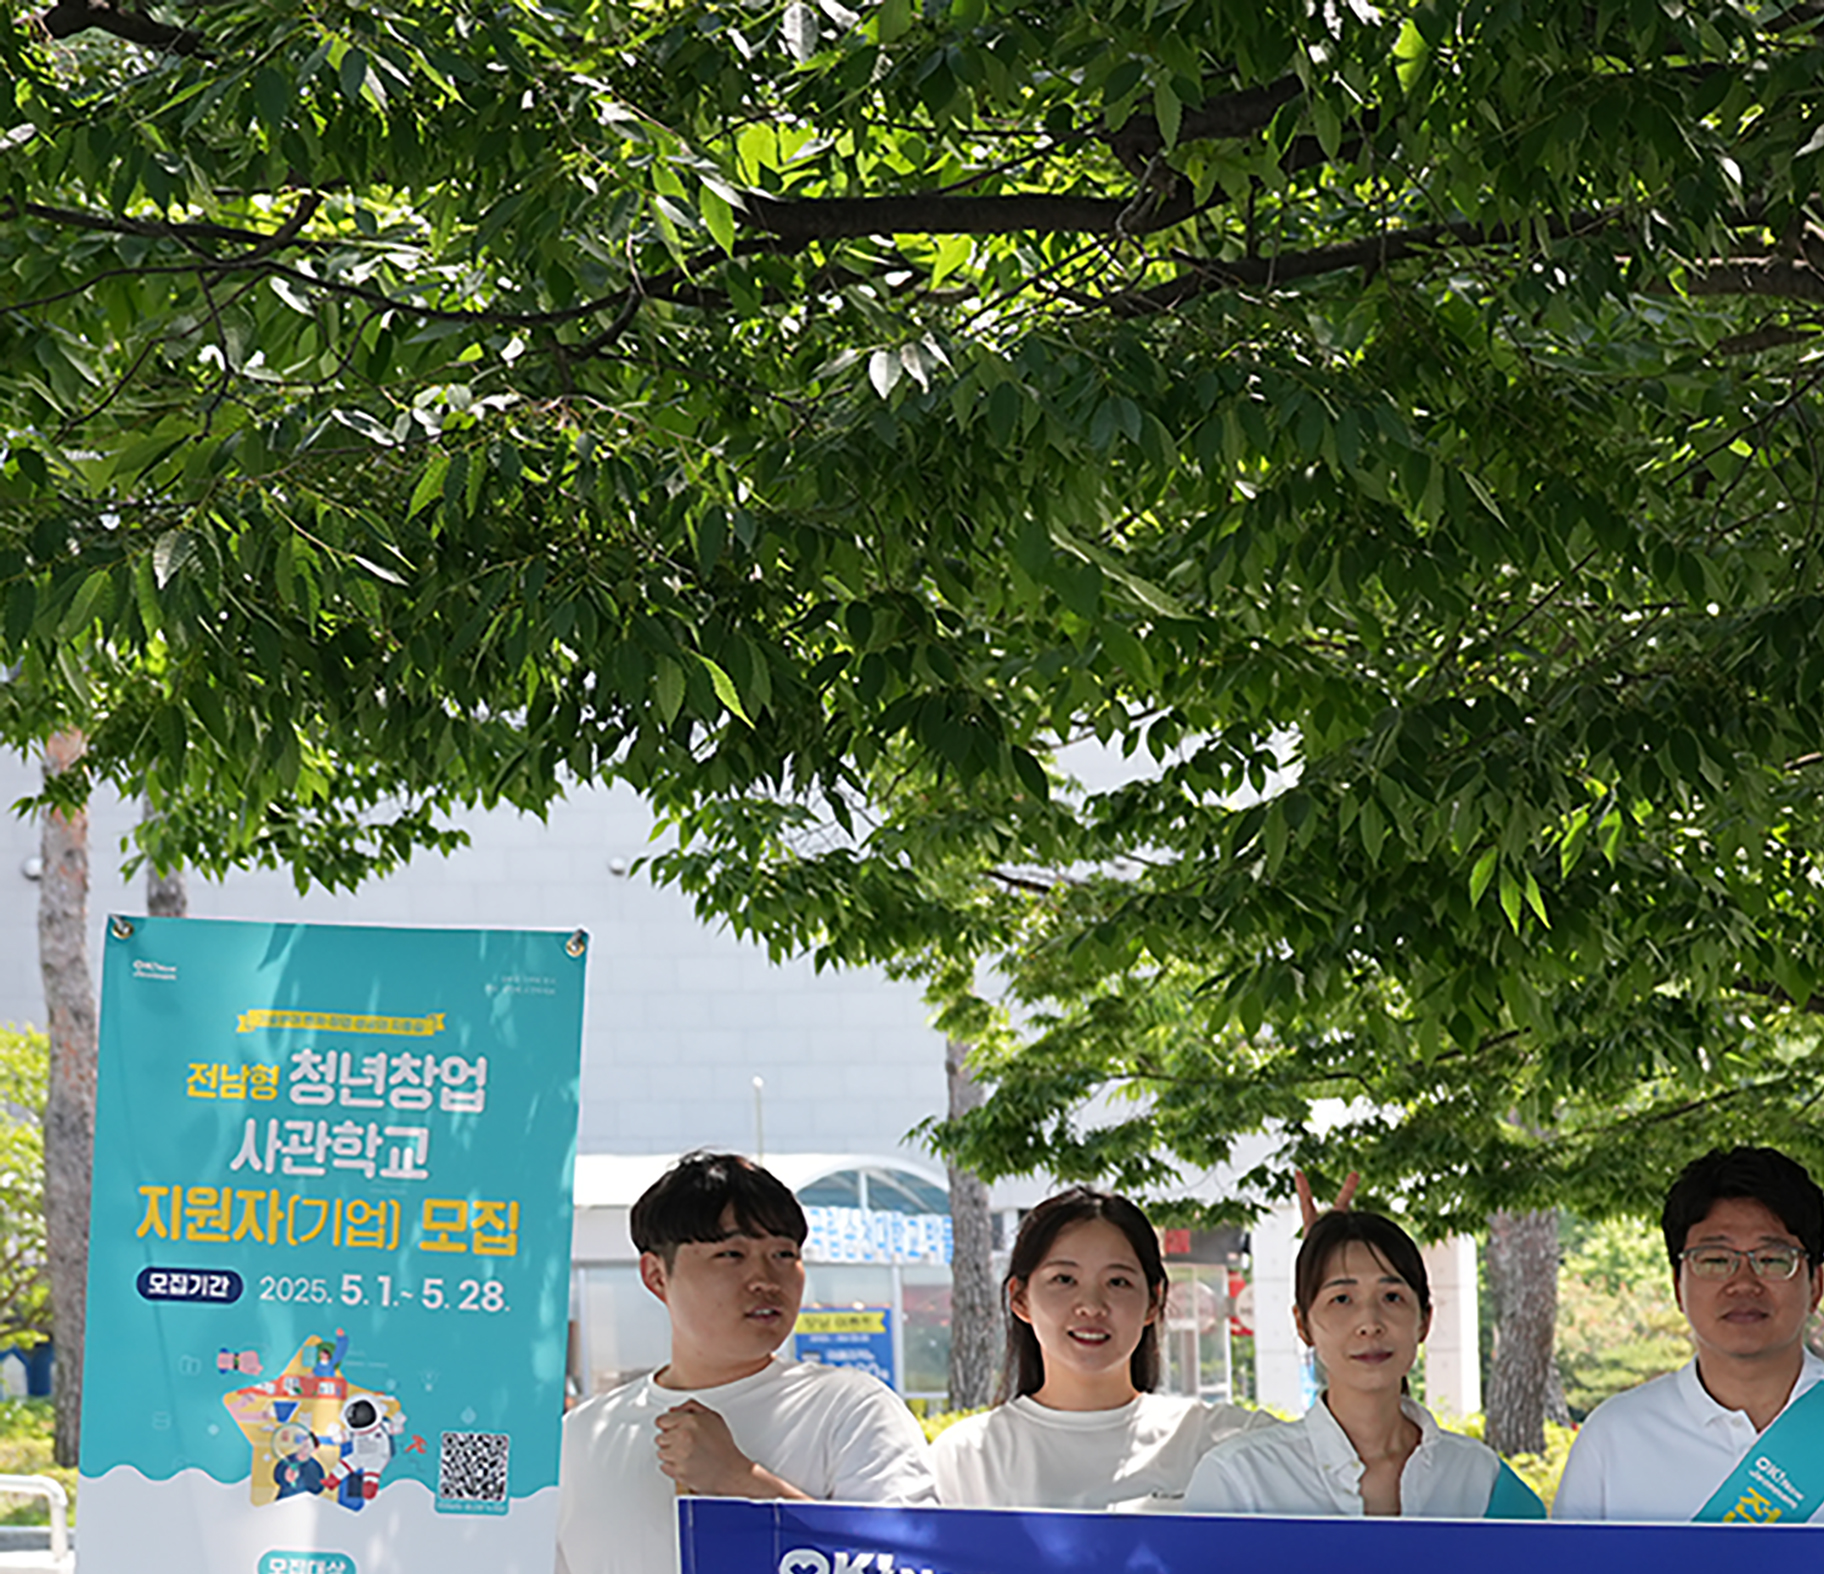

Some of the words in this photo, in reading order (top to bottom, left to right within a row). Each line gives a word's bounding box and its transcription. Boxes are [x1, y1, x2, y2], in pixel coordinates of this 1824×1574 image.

[187, 1064, 279, 1100] 전남형
[290, 1048, 487, 1113] 청년창업
[230, 1119, 429, 1179] 사관학교
[137, 1185, 400, 1250] 지원자(기업)
[419, 1199, 519, 1256] 모집
[149, 1273, 229, 1297] 모집기간
